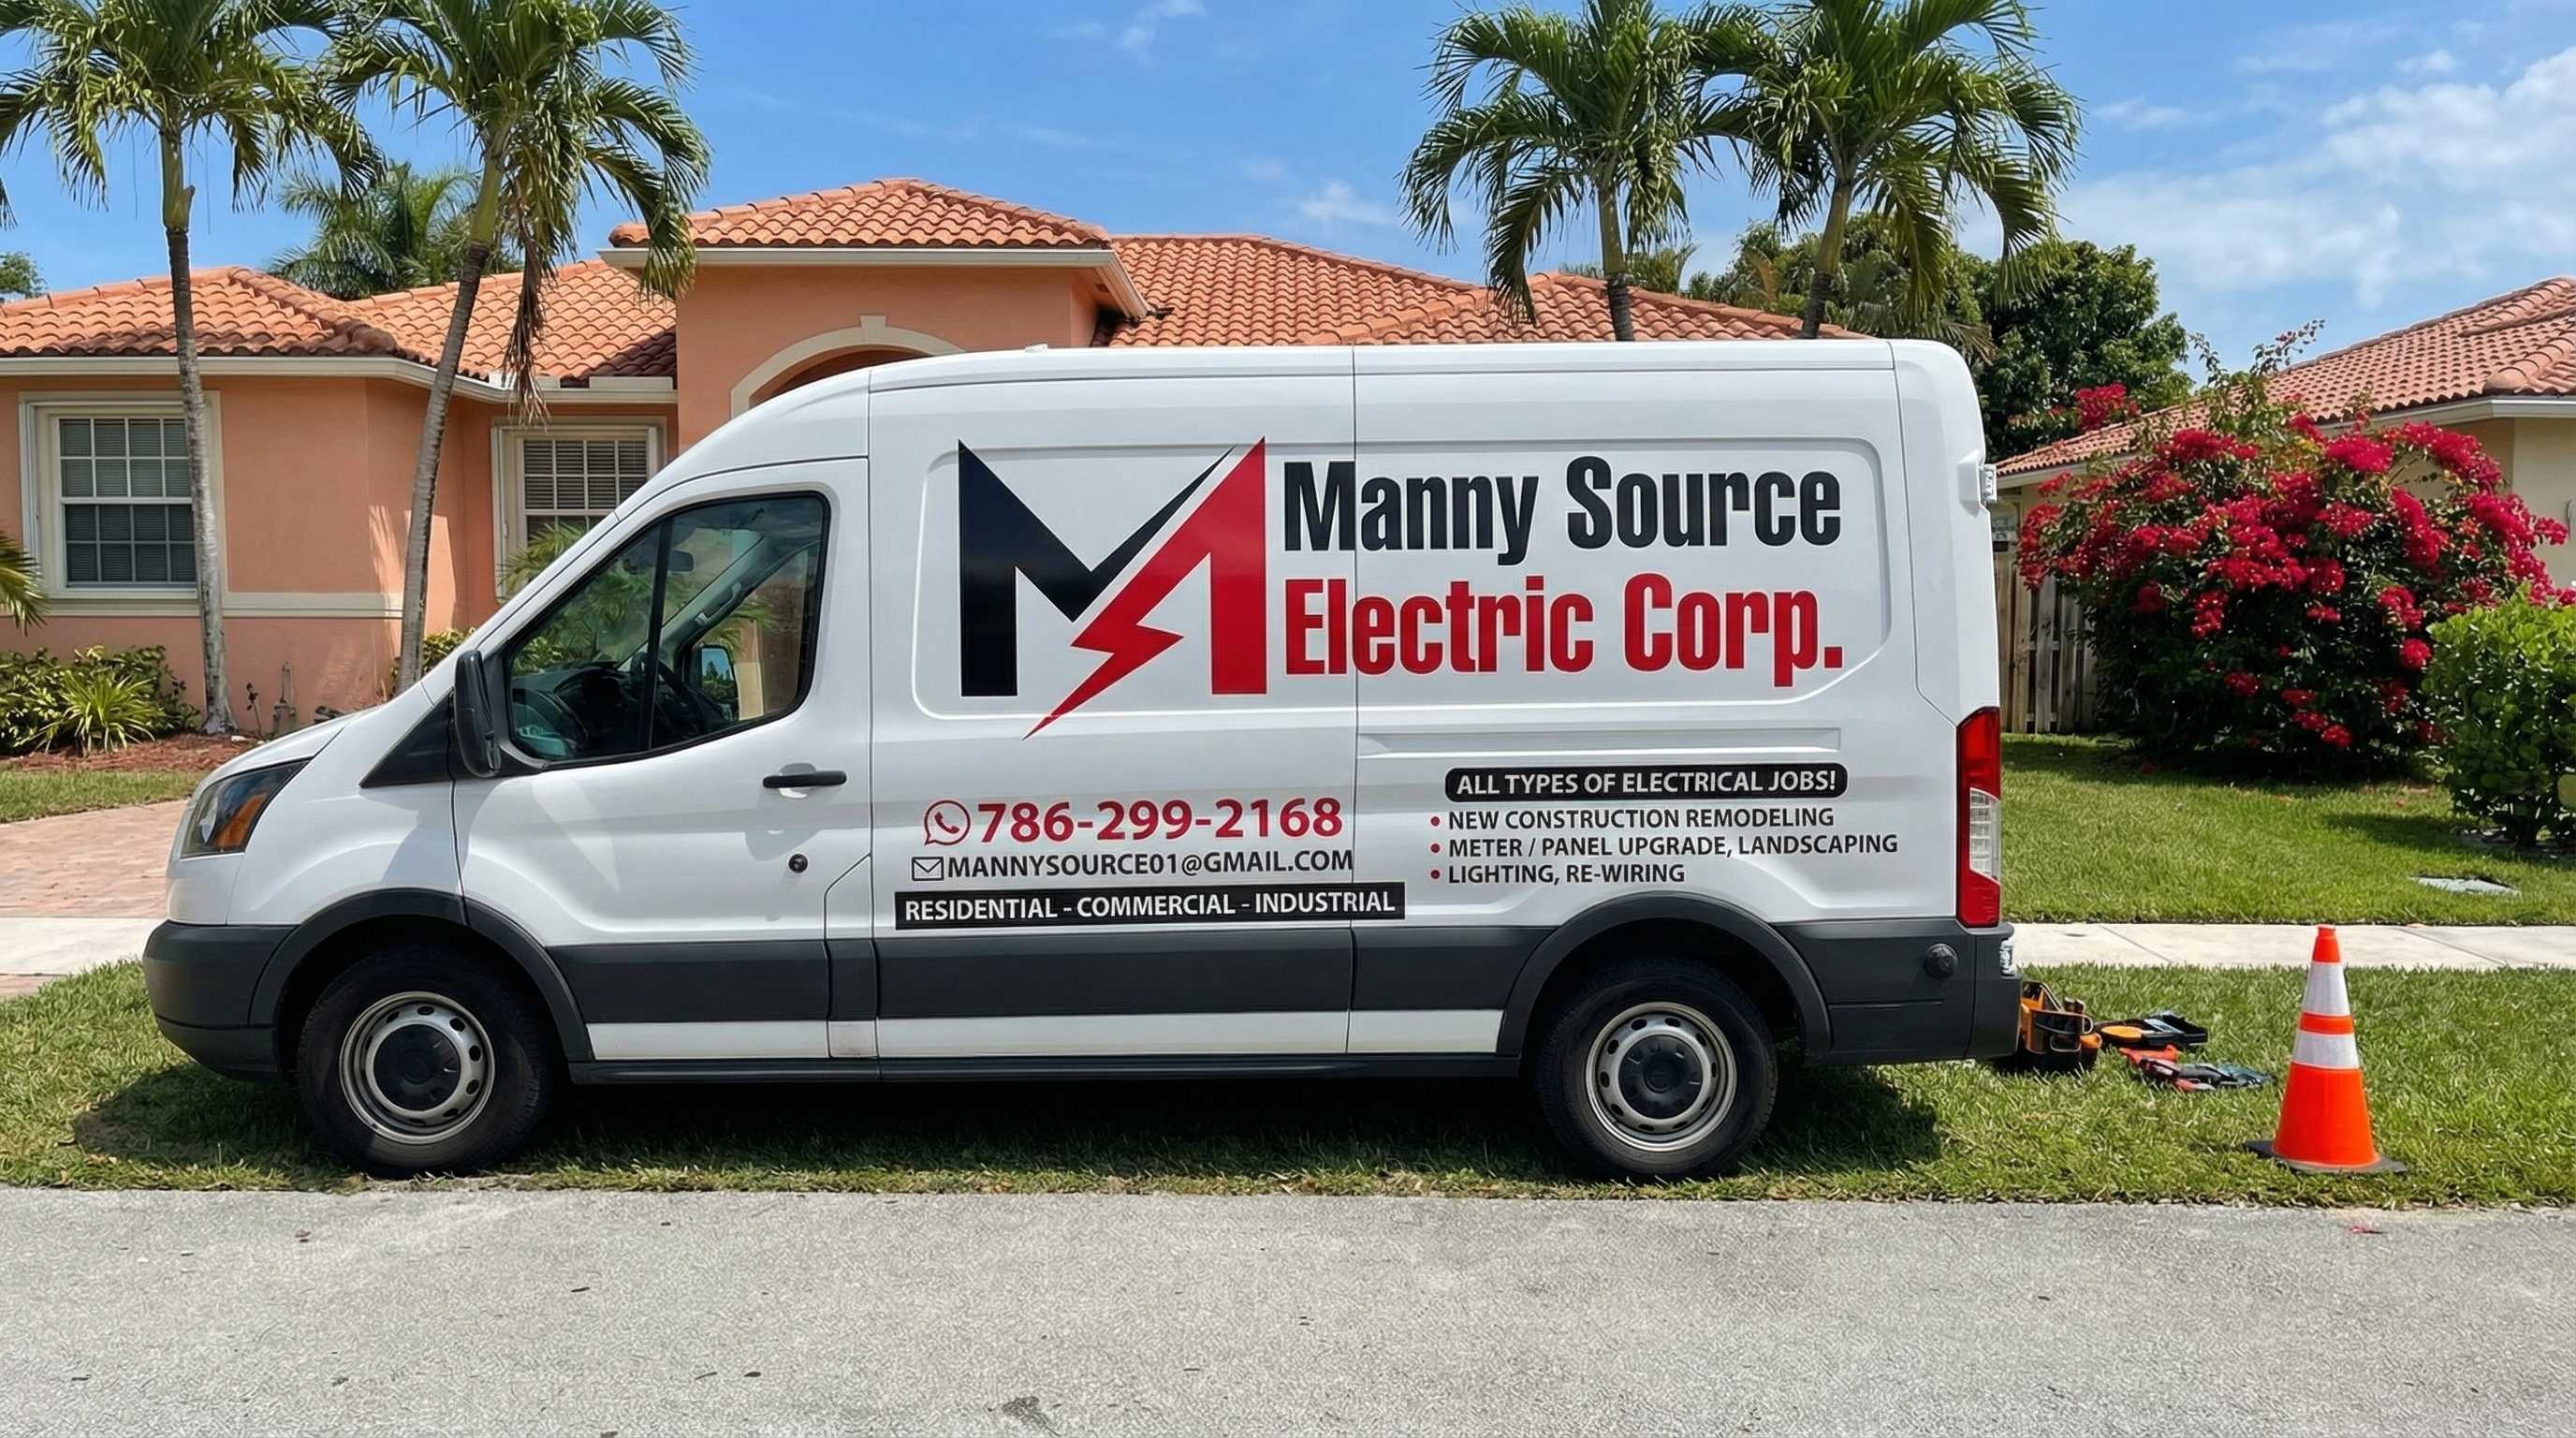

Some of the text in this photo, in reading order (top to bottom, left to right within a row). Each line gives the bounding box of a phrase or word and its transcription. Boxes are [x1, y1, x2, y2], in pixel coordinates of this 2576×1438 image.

[1283, 455, 1841, 566] Manny Source
[1284, 572, 1843, 688] Electric Corp.
[1456, 770, 1836, 795] ALL TYPES OF ELECTRICAL JOBS!
[979, 798, 1343, 844] 786-299-2168
[1449, 807, 1834, 830] NEW CONSTRUCTION REMODELING
[1449, 838, 1523, 858] METER
[1542, 837, 1613, 857] PANEL
[1618, 836, 1732, 858] UPGRADE,
[1738, 833, 1897, 855] LANDSCAPING
[946, 849, 1354, 879] MANNYSOURCE01@GMAIL.COM
[1448, 863, 1685, 886] LIGHTING, RE-WIRING
[905, 898, 1058, 921] RESIDENTIAL
[1076, 894, 1237, 917] COMMERCIAL
[1255, 890, 1396, 913] INDUSTRIAL
